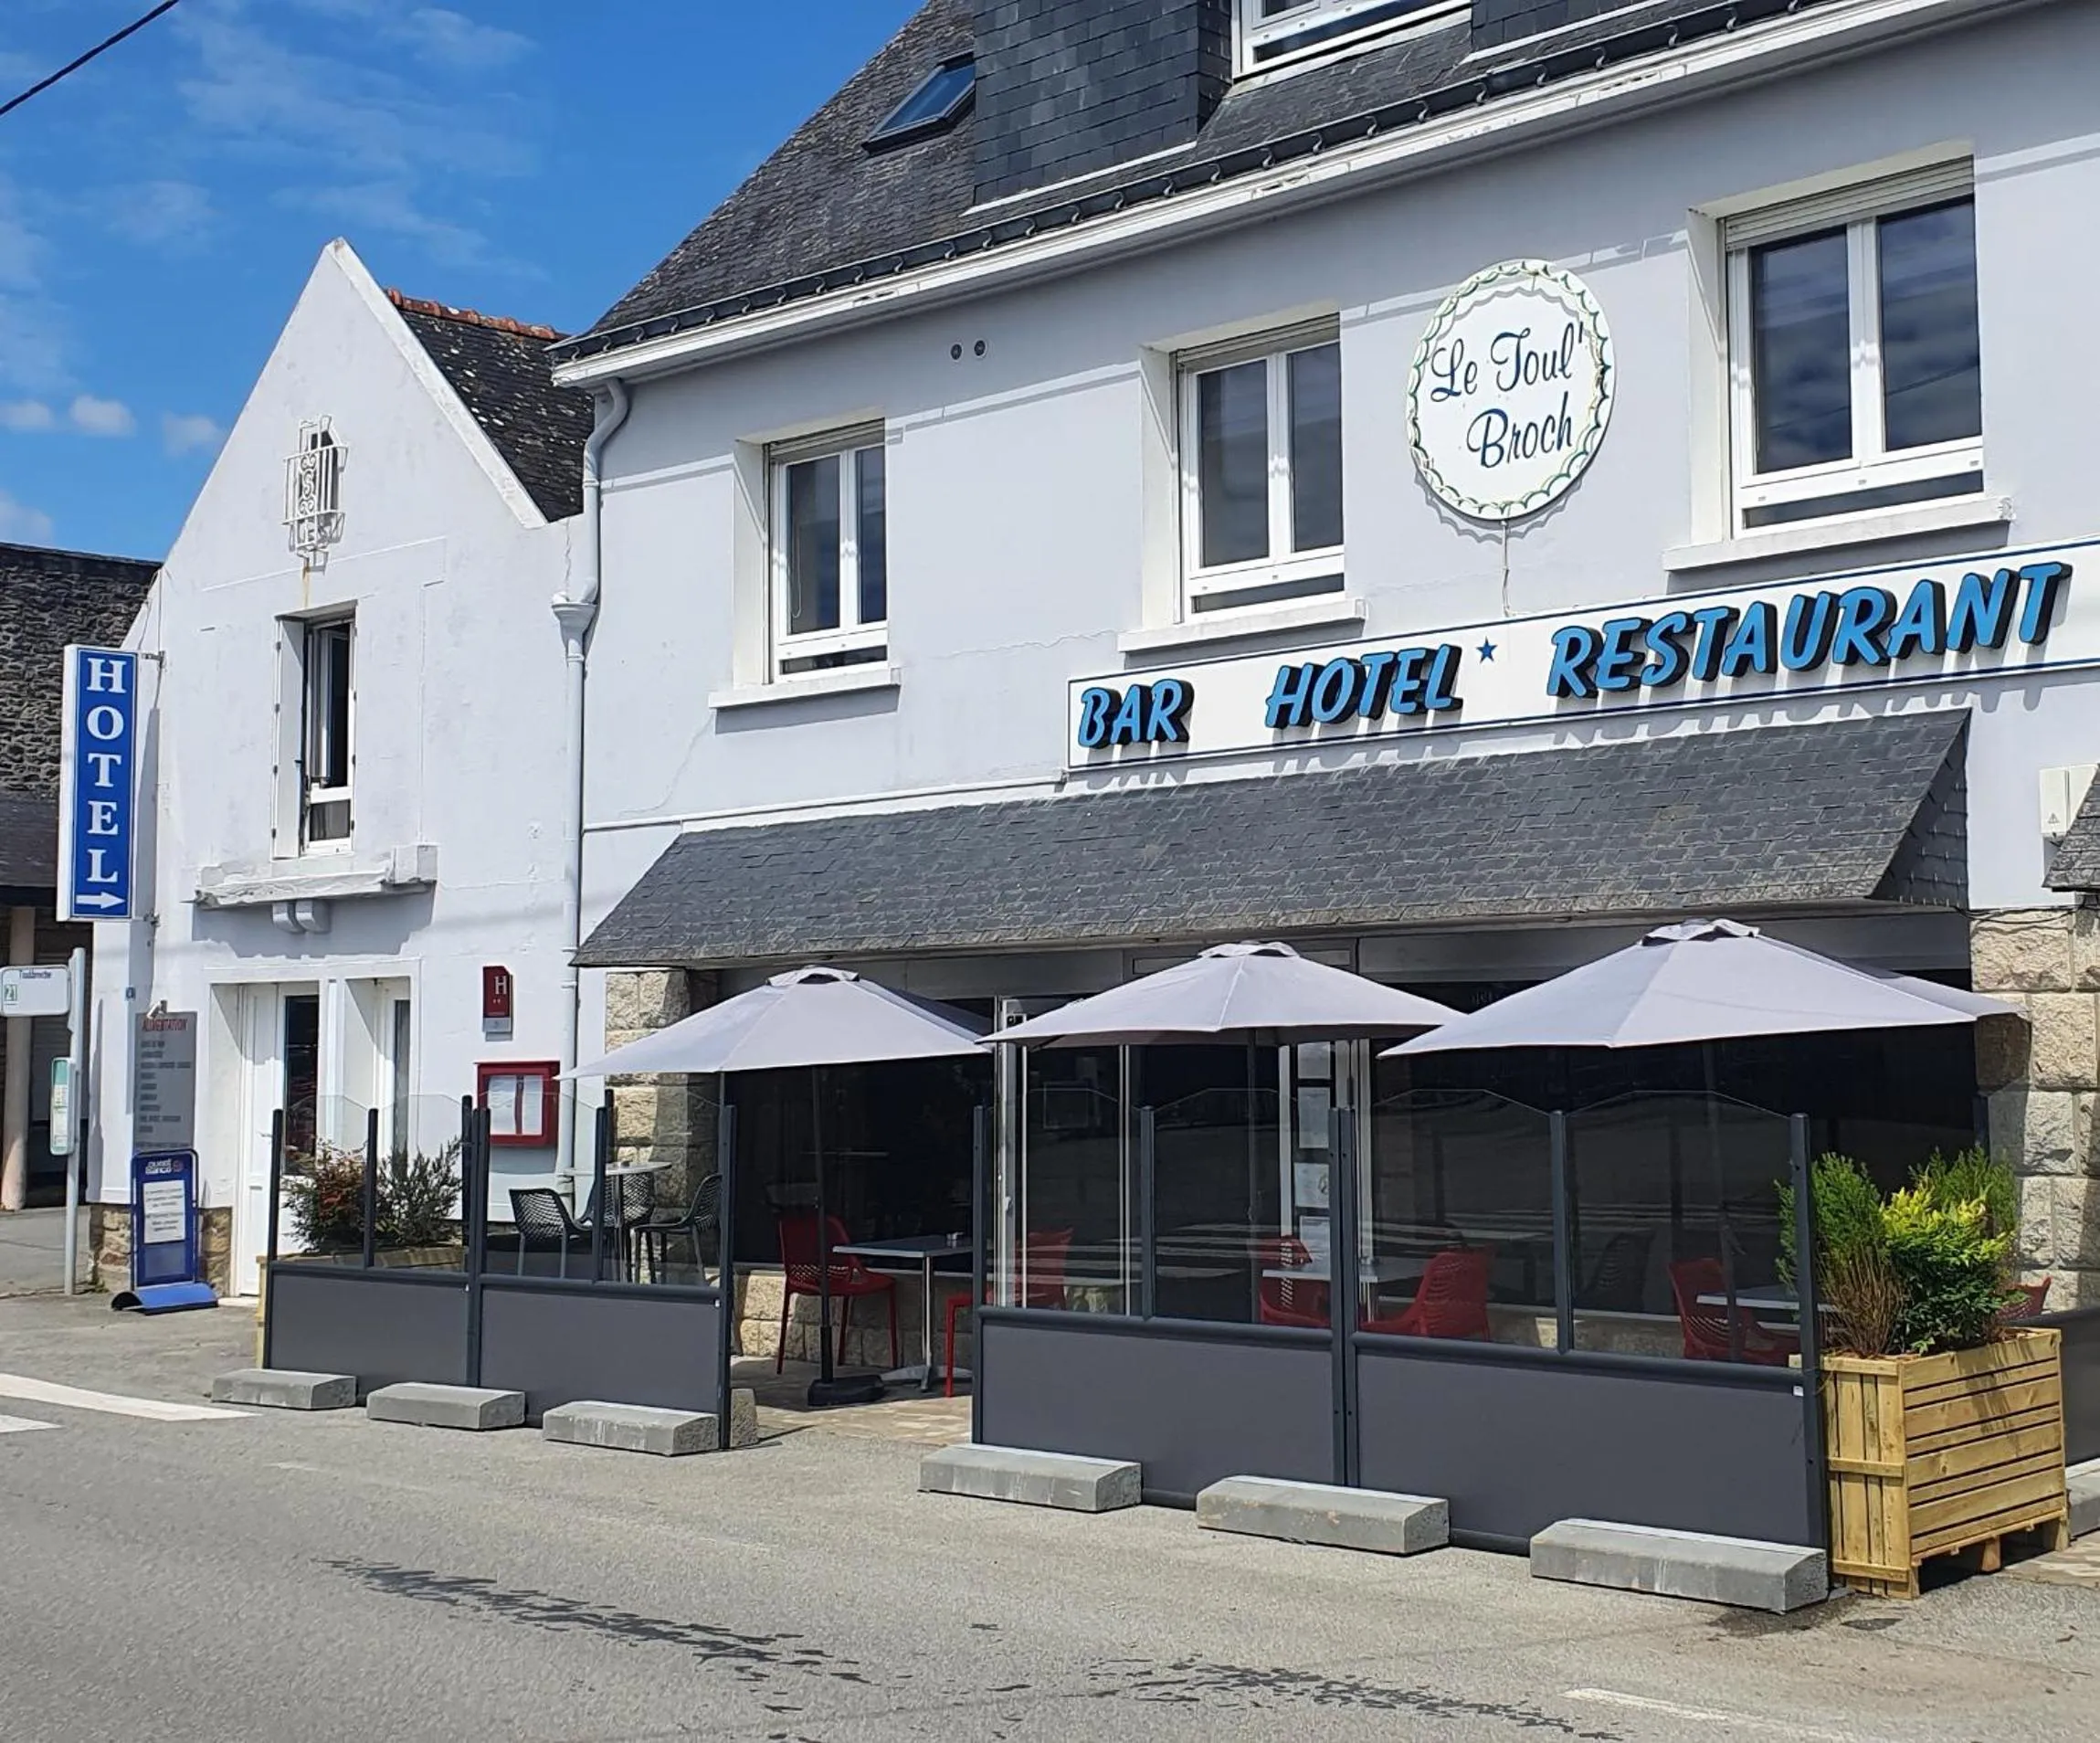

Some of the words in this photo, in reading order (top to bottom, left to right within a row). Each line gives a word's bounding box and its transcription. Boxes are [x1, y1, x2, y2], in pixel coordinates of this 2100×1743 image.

[1430, 339, 1477, 402] Le
[1491, 322, 1583, 392] Toul'
[1467, 391, 1572, 468] Broch
[1079, 679, 1192, 748] BAR
[1266, 644, 1462, 729] HOTEL
[1546, 561, 2071, 699] RESTAURANT
[86, 657, 127, 883] HOTEL
[495, 976, 507, 994] H
